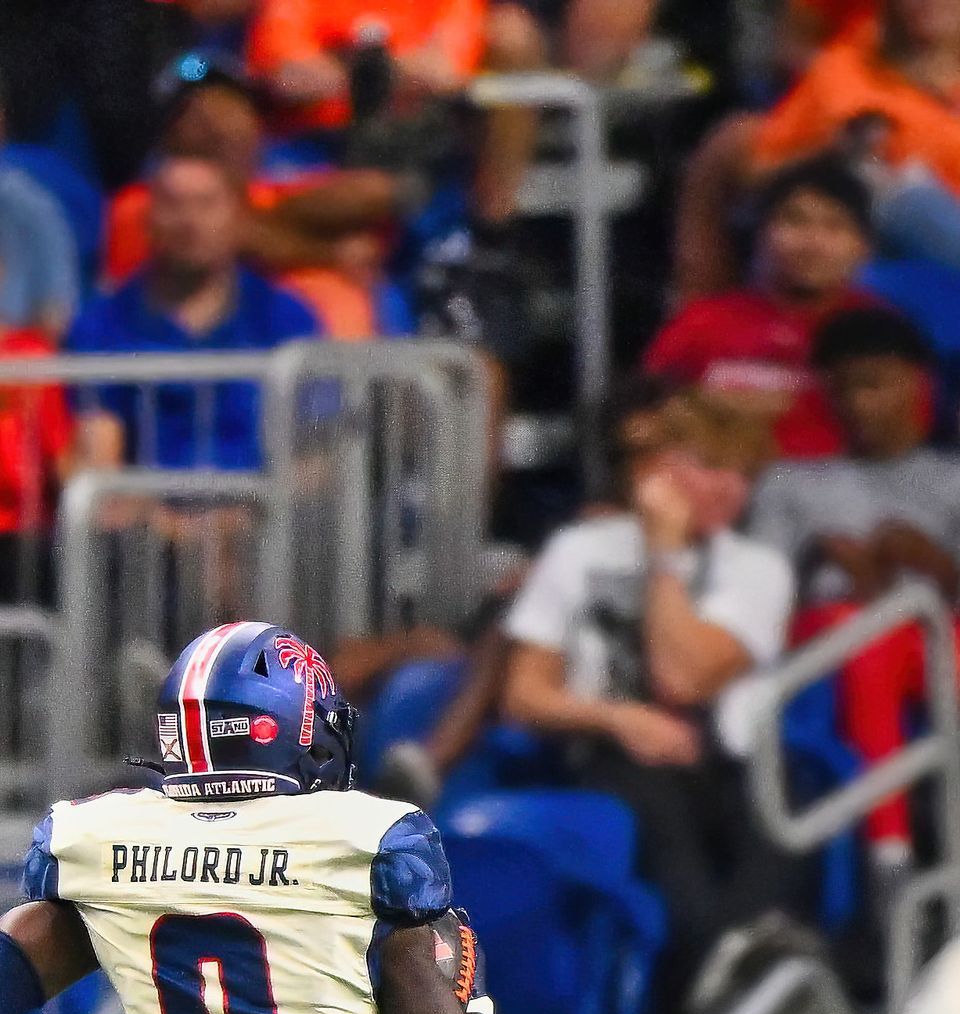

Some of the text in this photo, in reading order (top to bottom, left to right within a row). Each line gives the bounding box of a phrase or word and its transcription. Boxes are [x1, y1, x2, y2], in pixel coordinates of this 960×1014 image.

[211, 720, 248, 735] STAND
[204, 778, 275, 796] ATLANTIC
[111, 844, 299, 886] PHILORD JR.
